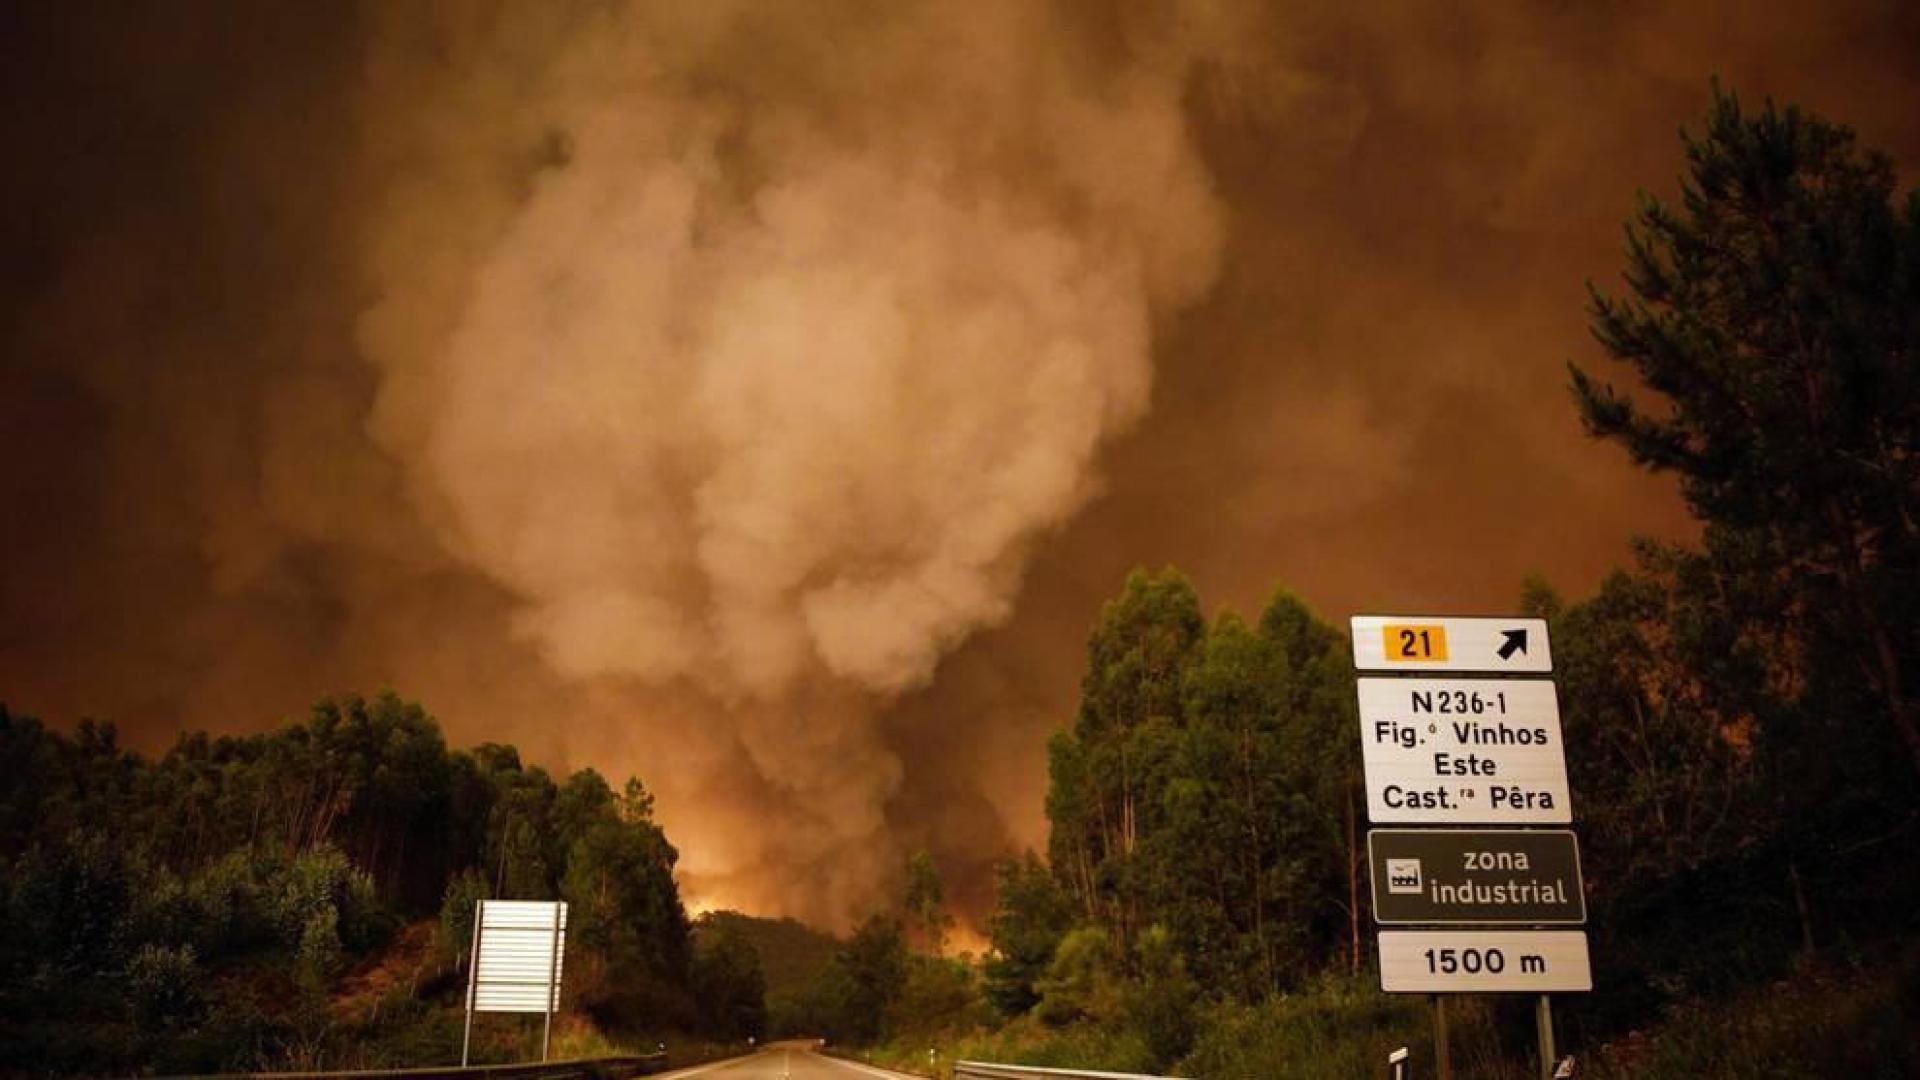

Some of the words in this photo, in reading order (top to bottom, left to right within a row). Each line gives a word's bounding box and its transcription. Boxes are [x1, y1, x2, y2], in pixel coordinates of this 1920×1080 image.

[1400, 629, 1431, 657] 21
[1453, 722, 1548, 745] Vinhos
[1435, 753, 1496, 776] Este
[1490, 786, 1555, 809] Pêra
[1463, 852, 1529, 871] zona
[1430, 878, 1568, 904] industrial
[1424, 948, 1505, 974] 1500
[1520, 954, 1545, 974] m
